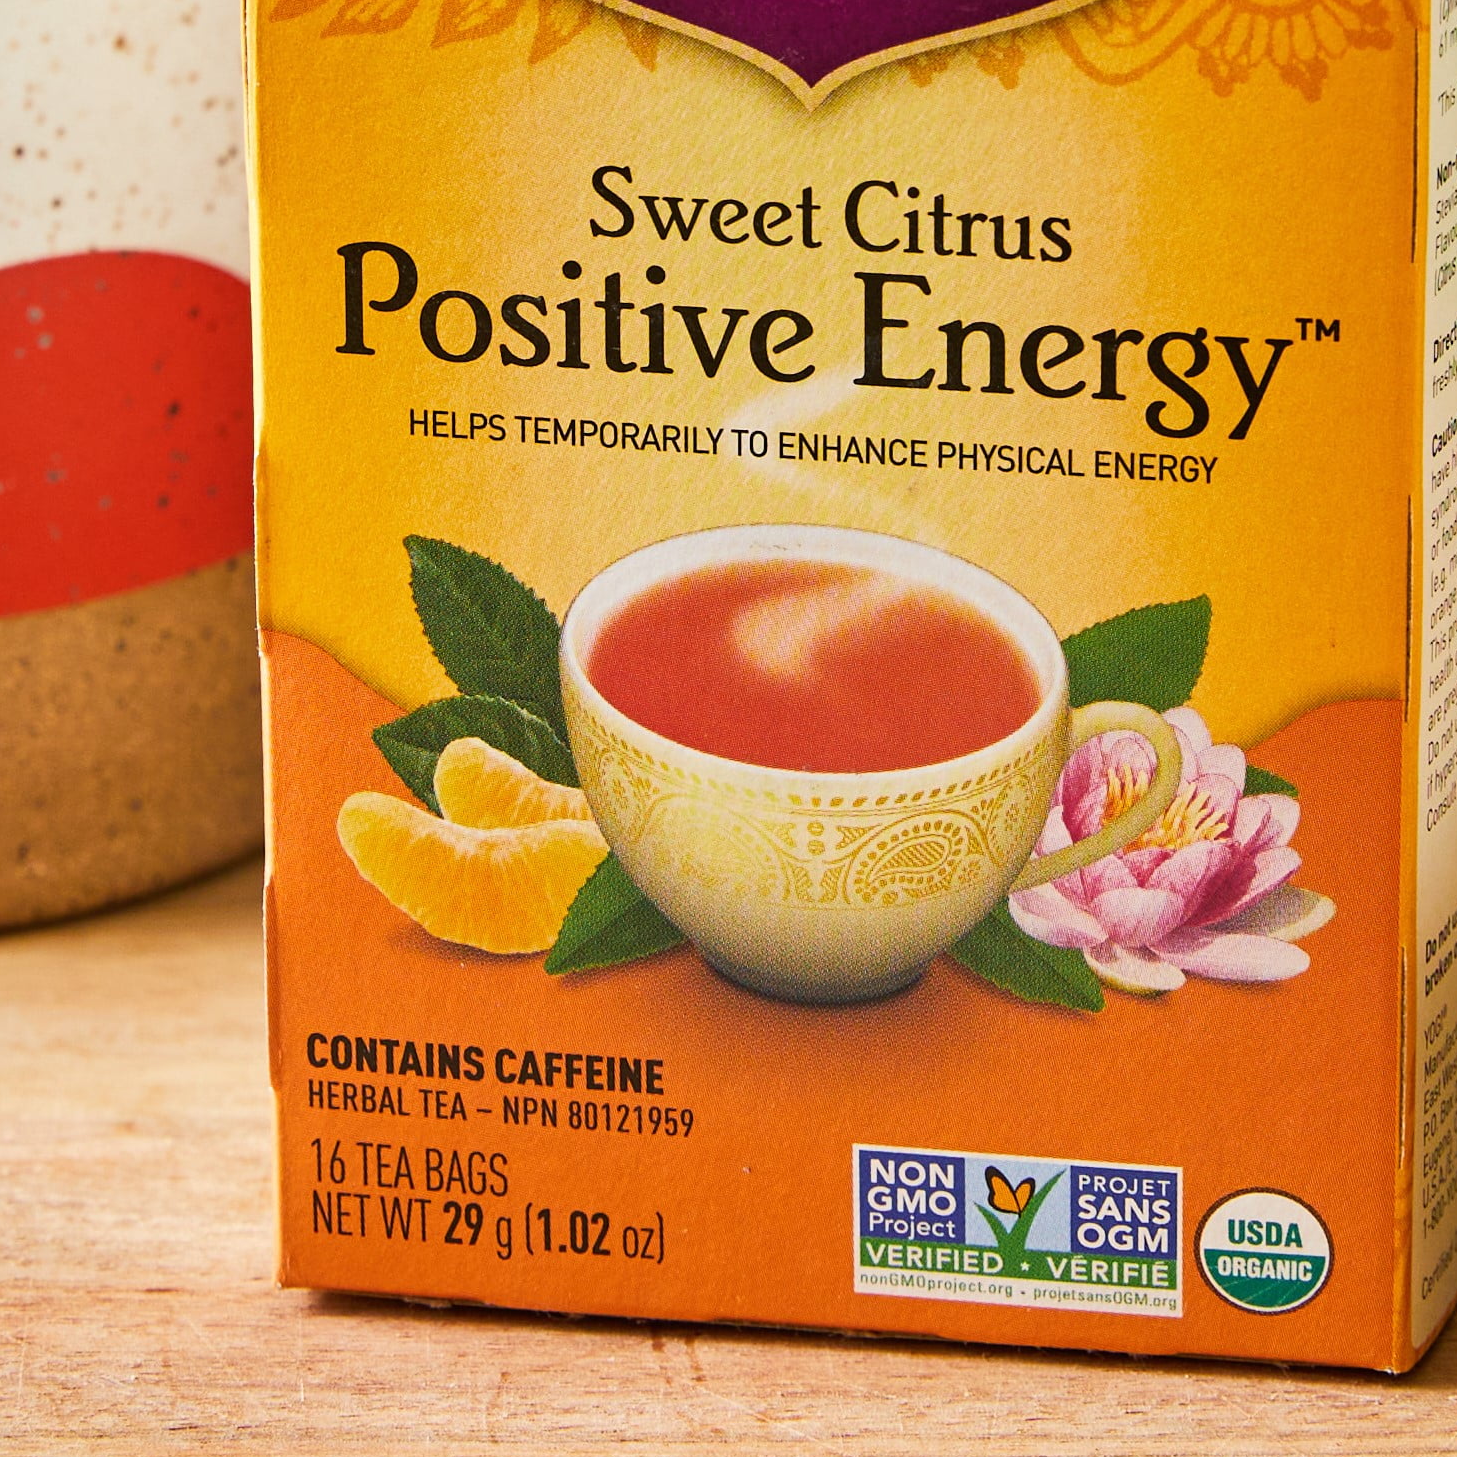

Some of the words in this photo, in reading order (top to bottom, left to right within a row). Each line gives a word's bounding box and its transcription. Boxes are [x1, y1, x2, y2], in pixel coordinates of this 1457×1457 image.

[589, 165, 823, 249] Sweet
[844, 179, 1073, 263] Citrus
[1435, 186, 1457, 225] Stevia
[1434, 256, 1455, 296] (Citrus
[335, 241, 816, 383] Positive
[1432, 357, 1457, 398] freshly
[409, 407, 507, 442] HELPS
[514, 415, 724, 456] TEMPORARILY
[731, 428, 769, 458] TO
[778, 431, 928, 468] ENHANCE
[937, 440, 1086, 478] PHYSICAL
[1094, 450, 1218, 485] ENERGY
[1431, 460, 1449, 492] have
[1431, 537, 1440, 561] or
[1430, 586, 1456, 630] orange
[1430, 632, 1446, 661] This
[1429, 653, 1453, 698] health
[1428, 704, 1441, 732] are
[1428, 740, 1439, 766] Do
[1441, 719, 1452, 751] not
[1426, 780, 1456, 833] Consult
[1425, 938, 1436, 964] Do
[1439, 915, 1450, 948] not
[1424, 949, 1452, 998] broken
[306, 1032, 485, 1081] CONTAINS
[495, 1048, 664, 1096] CAFFEINE
[308, 1079, 410, 1117] HERBAL
[419, 1088, 467, 1121] TEA
[503, 1094, 558, 1128] NPN
[568, 1100, 694, 1138] 80121959
[1423, 1077, 1440, 1115] East
[311, 1138, 346, 1185] 16
[356, 1142, 415, 1190] TEA
[425, 1148, 509, 1197] BAGS
[869, 1158, 955, 1190] NON
[1078, 1174, 1172, 1197] PROJET
[867, 1185, 958, 1216] GMO
[1077, 1194, 1172, 1225] SANS
[312, 1189, 371, 1238] NET
[380, 1196, 432, 1243] WT
[443, 1201, 484, 1246] 29
[495, 1215, 513, 1261] g
[524, 1202, 611, 1257] (1.02
[622, 1211, 664, 1265] oz)
[868, 1212, 956, 1240] Project
[1076, 1223, 1170, 1254] OGM
[1227, 1219, 1303, 1248] USDA
[865, 1242, 1004, 1275] VERIFIED
[1047, 1254, 1170, 1287] VÉRIFIÉ
[1216, 1254, 1314, 1282] ORGANIC
[859, 1272, 1014, 1299] nonGMOproject.org
[1032, 1285, 1178, 1311] projetsansOGM.org
